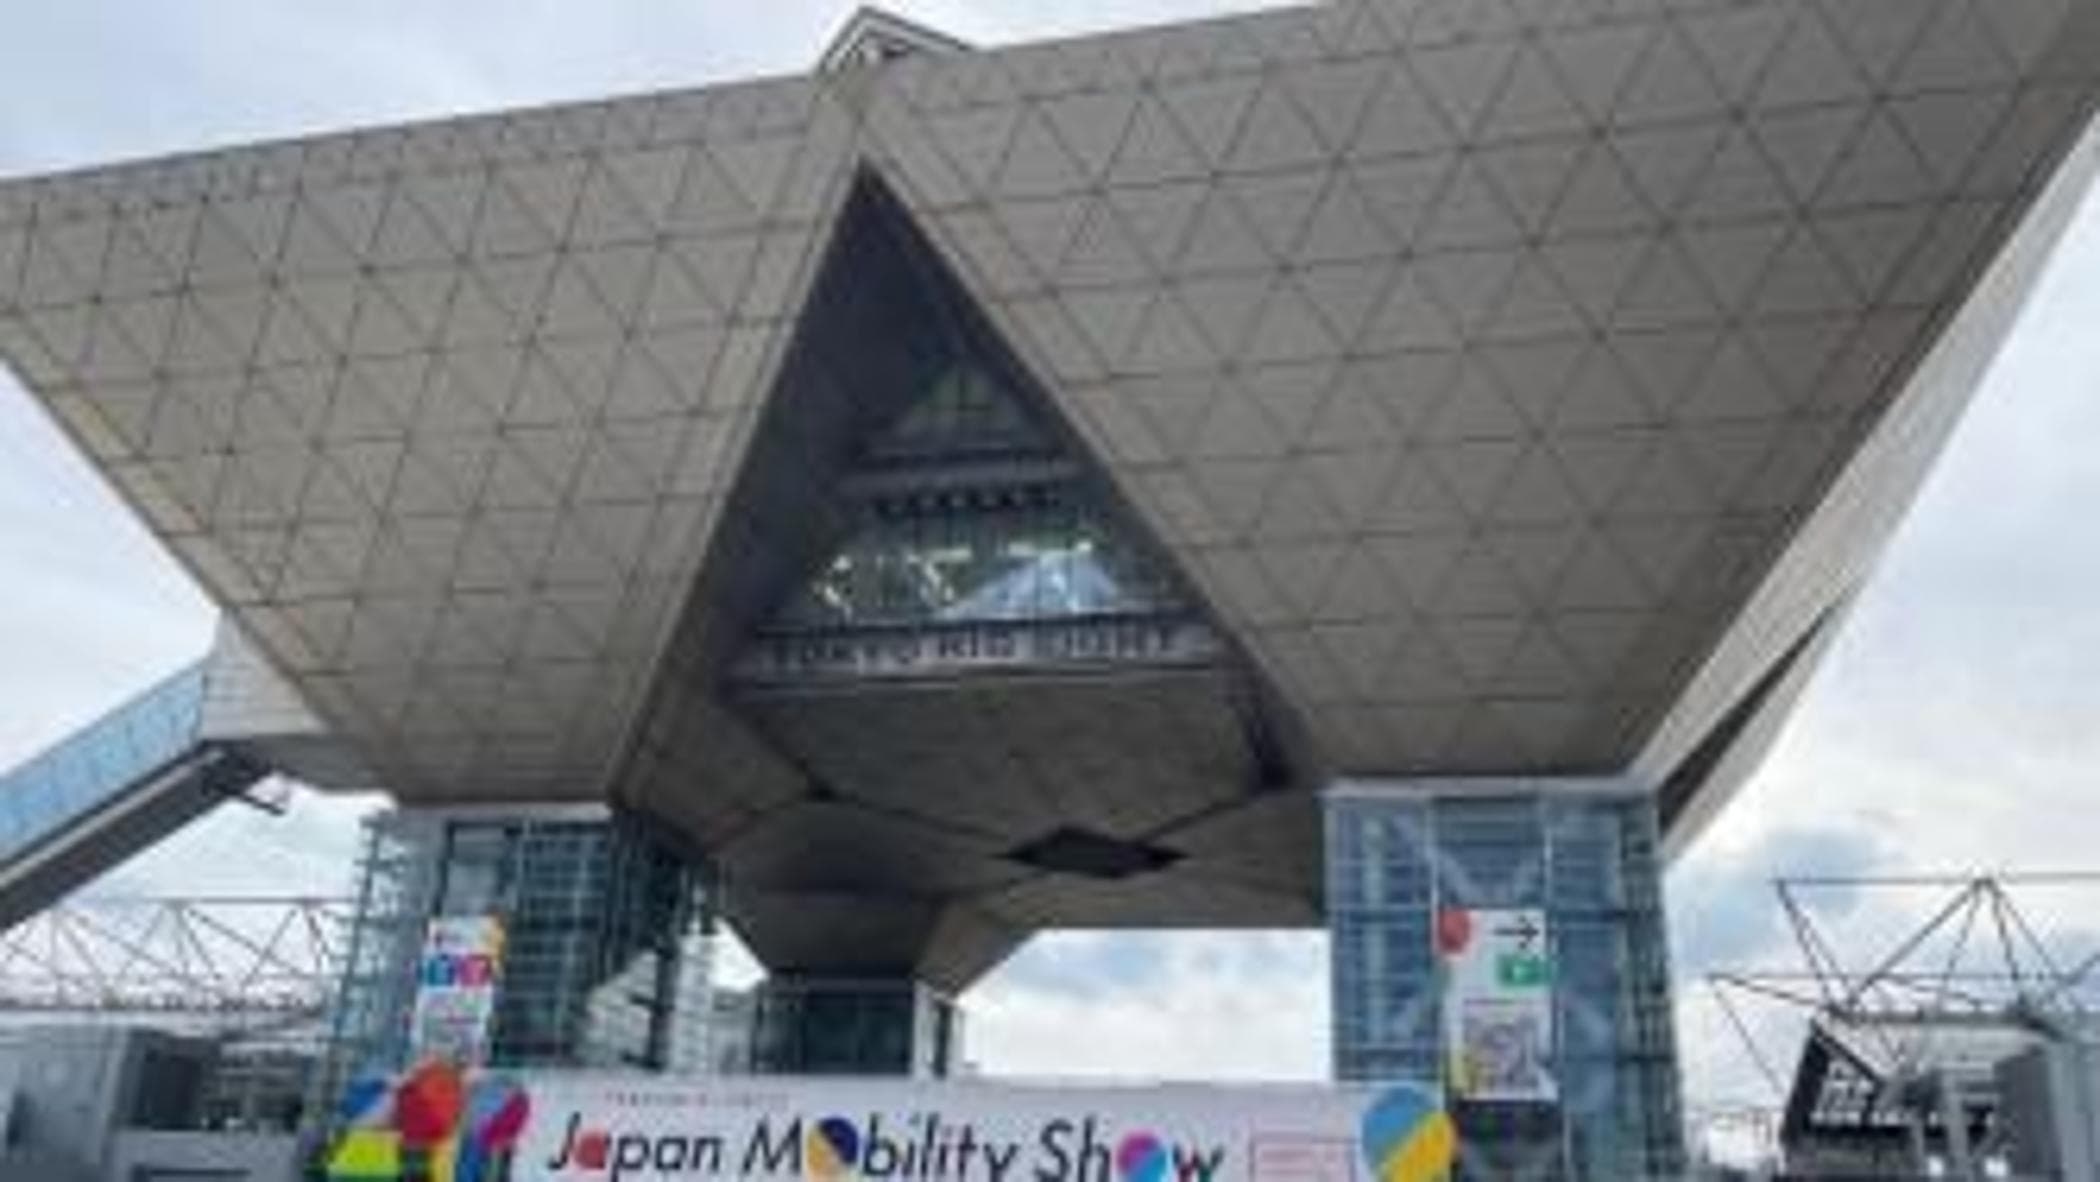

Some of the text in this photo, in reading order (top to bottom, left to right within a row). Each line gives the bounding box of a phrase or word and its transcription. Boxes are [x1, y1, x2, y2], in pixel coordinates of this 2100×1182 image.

[547, 1112, 722, 1182] Japan
[741, 1111, 1018, 1182] Mobility
[1032, 1115, 1226, 1182] Show
